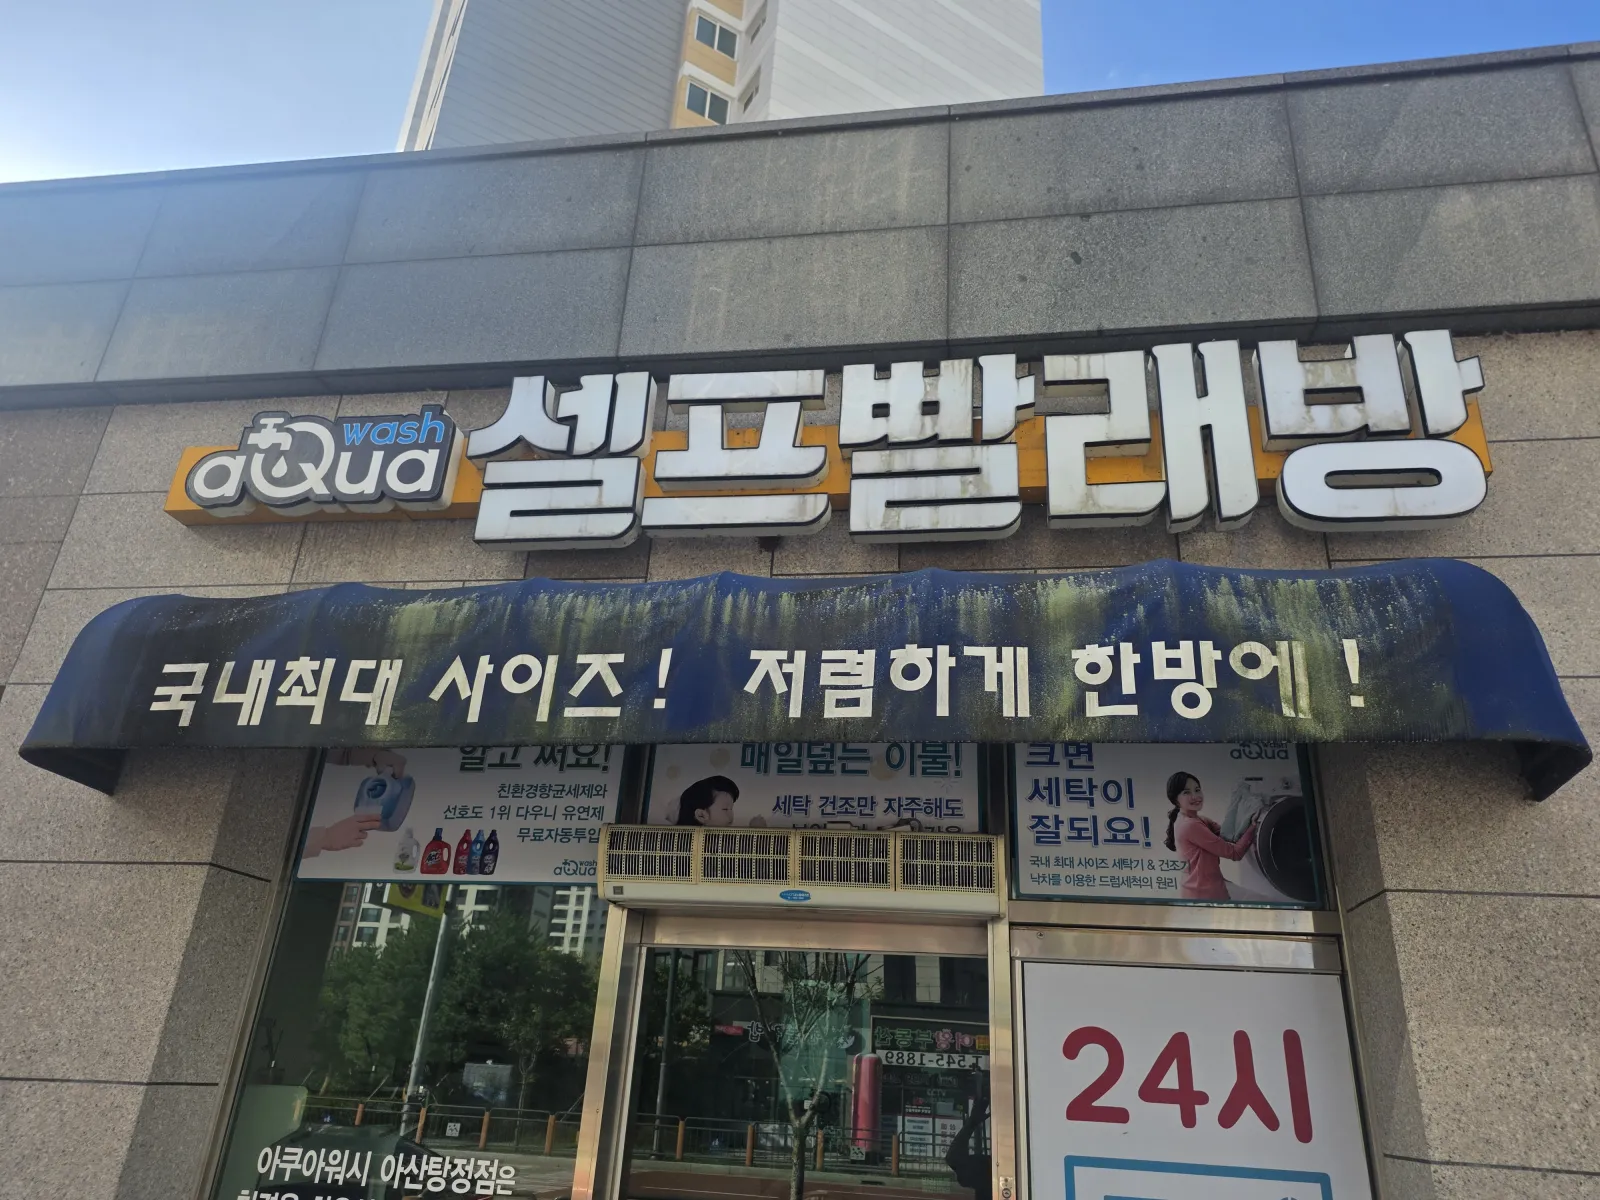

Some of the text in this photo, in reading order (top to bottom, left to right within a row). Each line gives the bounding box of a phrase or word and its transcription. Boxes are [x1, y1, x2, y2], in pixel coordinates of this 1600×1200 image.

[342, 405, 446, 446] wash
[467, 329, 1485, 541] 셀프빨래방
[149, 656, 403, 727] 국내최대
[743, 643, 1030, 719] 저렴하게
[740, 743, 963, 777] 매일덮는 이불!
[1026, 743, 1095, 770] 크면
[772, 794, 964, 819] 세탁 건조만 자주해도
[1028, 777, 1135, 808] 세탁이
[443, 804, 605, 821] 선호도 1위 다우니 유연제
[516, 827, 601, 844] 무료자동투입
[1029, 814, 1151, 847] 잘되요!
[1029, 855, 1191, 872] 국내 최대 사이즈 세탁기 & 건조기
[1030, 873, 1178, 890] 낙차를 이용한 드럼세척의 원리
[1062, 1026, 1313, 1144] 24시
[257, 1146, 516, 1196] 아쿠아워시 아산탕정점은
